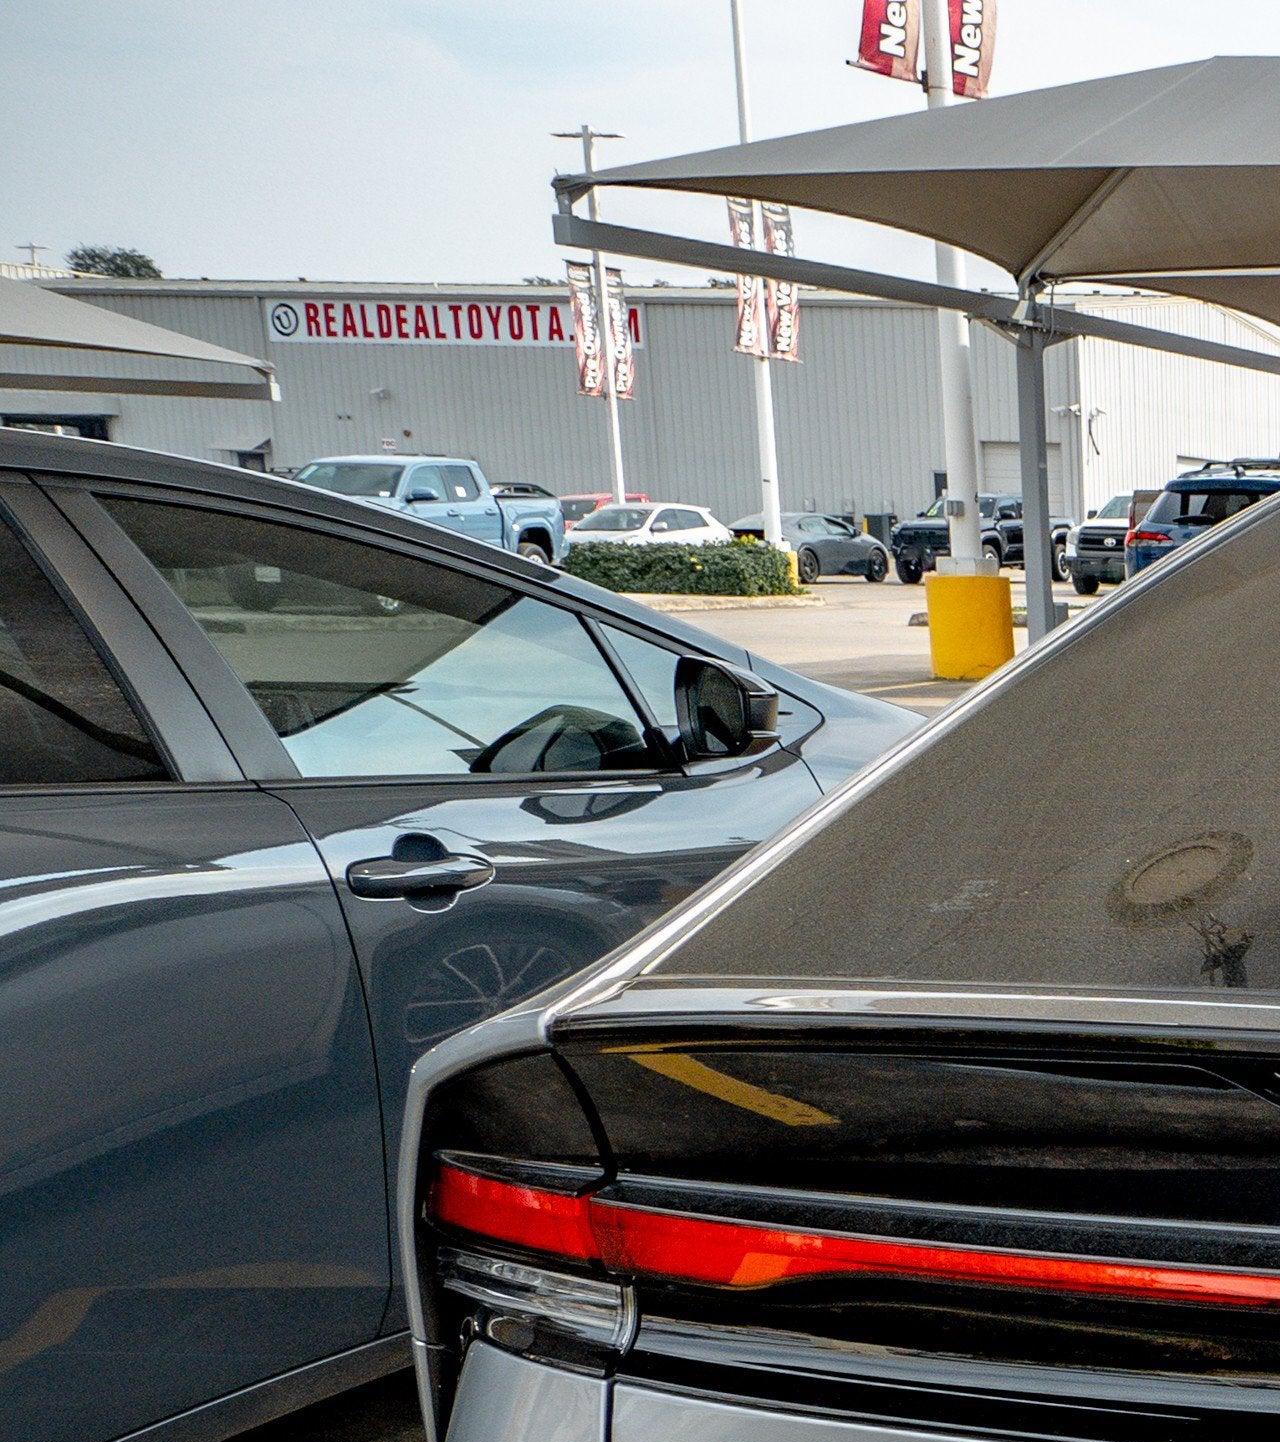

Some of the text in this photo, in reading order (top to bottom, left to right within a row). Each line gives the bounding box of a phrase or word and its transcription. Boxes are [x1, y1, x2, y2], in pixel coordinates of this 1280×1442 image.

[879, 0, 907, 57] Ne
[954, 0, 983, 77] New
[304, 303, 640, 343] REALDEALTOYOTA.M
[740, 303, 753, 346] New
[776, 309, 792, 352] New
